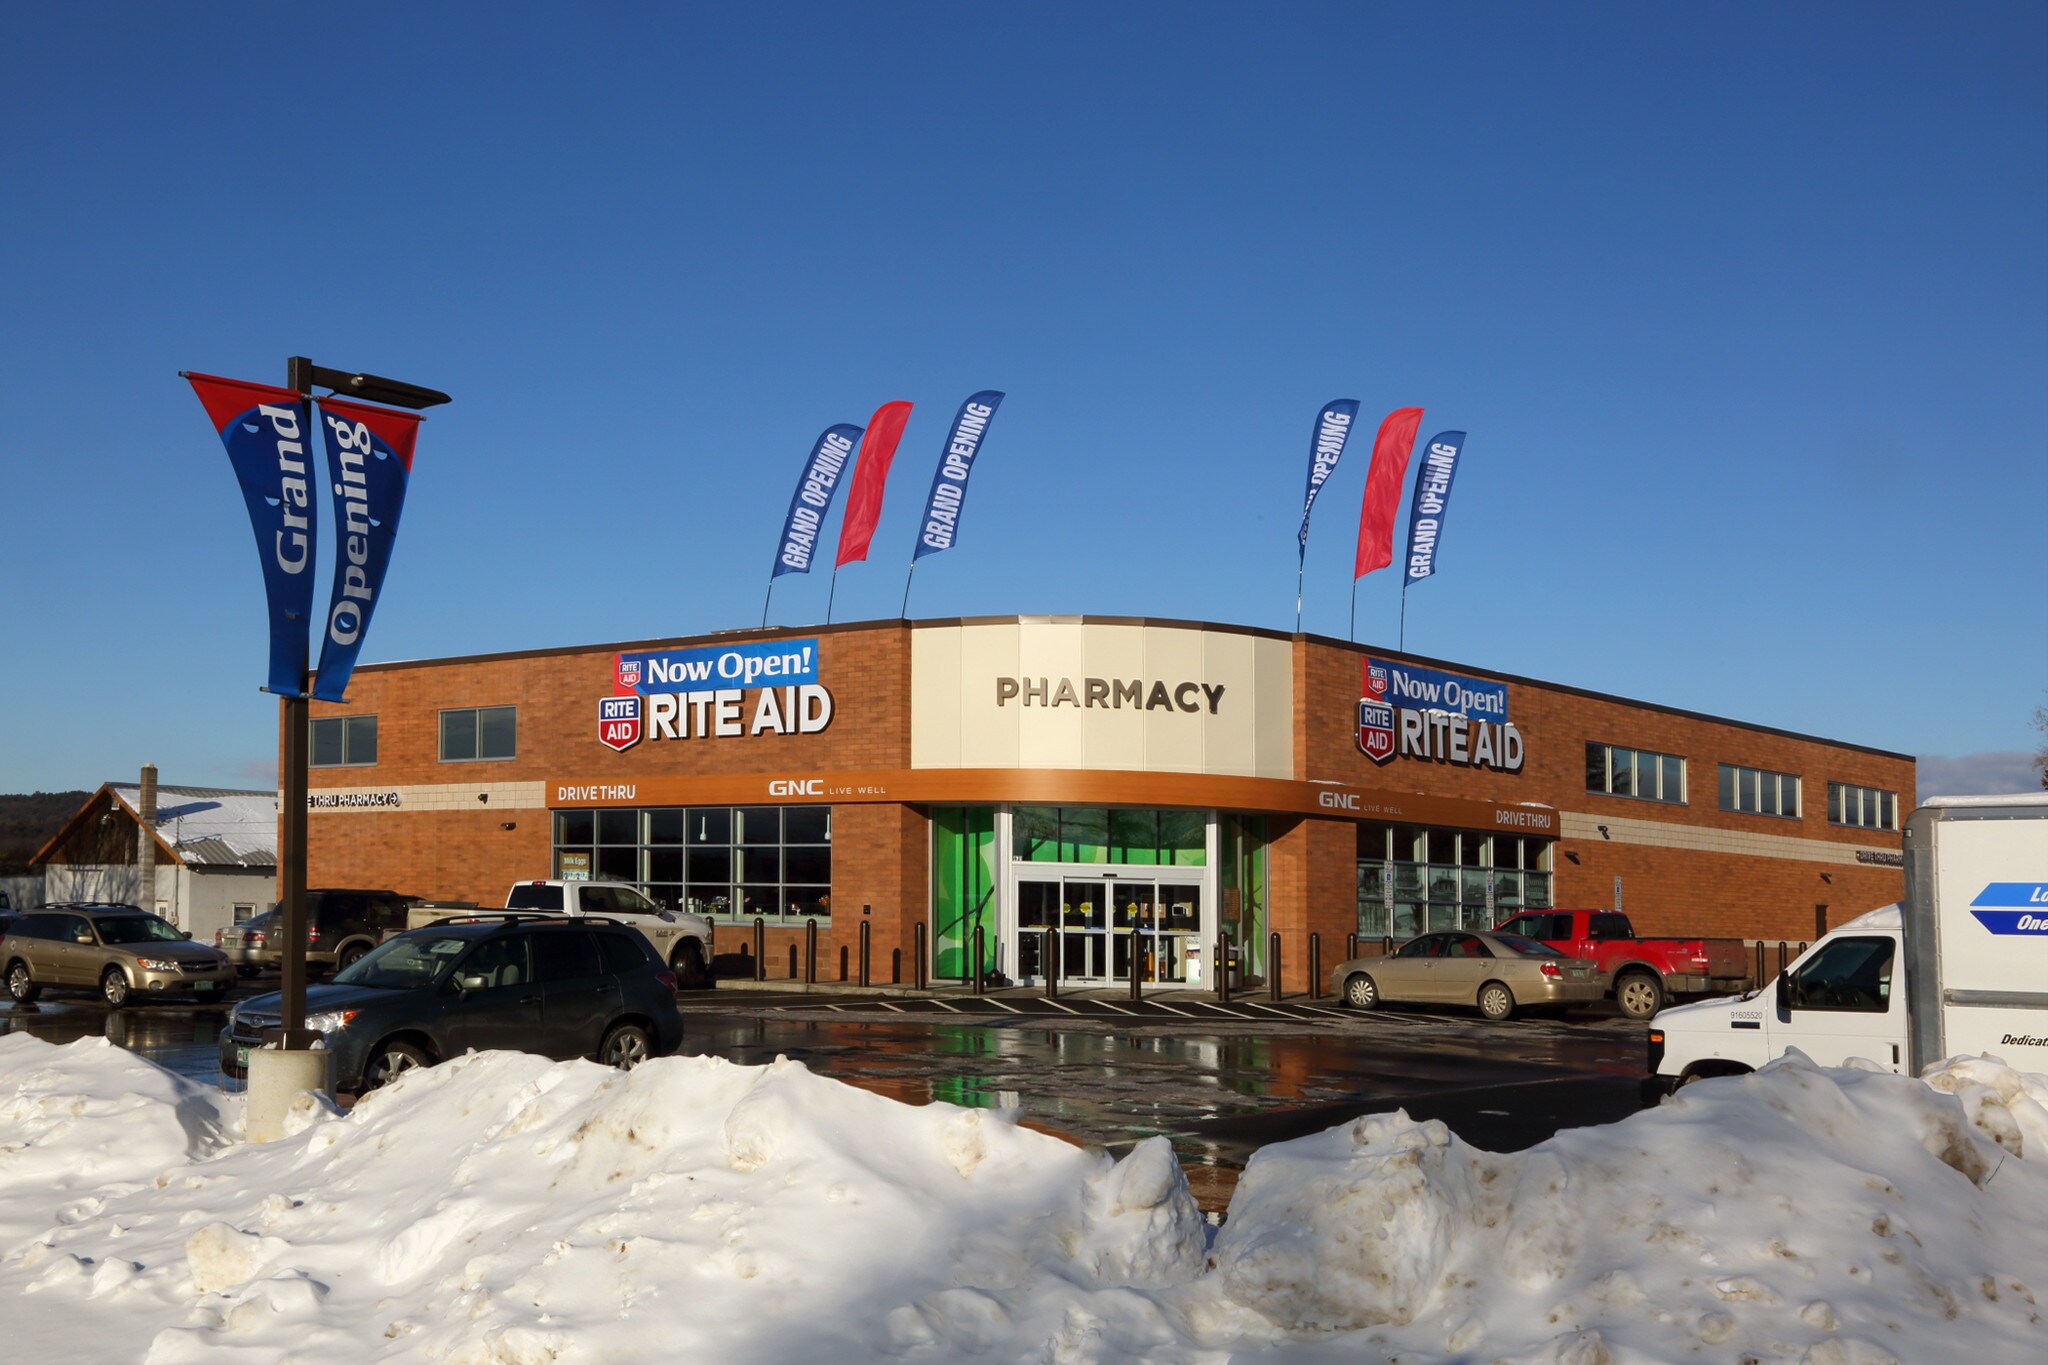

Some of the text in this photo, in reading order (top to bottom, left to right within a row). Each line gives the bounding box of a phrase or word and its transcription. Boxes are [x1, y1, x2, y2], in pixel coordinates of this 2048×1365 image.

[923, 402, 992, 549] GRAND OPENING
[258, 404, 308, 575] Grand
[782, 432, 853, 569] GRAND OPENING
[1409, 443, 1457, 578] GRAND OPENING
[329, 415, 373, 646] Opening
[620, 664, 640, 672] RITE
[648, 647, 811, 685] Now Open!
[1370, 668, 1385, 679] RITE
[622, 674, 638, 683] AID
[1372, 680, 1384, 689] AID
[996, 677, 1226, 715] PHARMACY
[1392, 670, 1504, 715] Now Open!
[605, 702, 635, 718] RITE
[649, 684, 832, 739] RITE AID
[1364, 710, 1390, 727] RITE
[606, 722, 632, 740] AID
[1404, 709, 1524, 769] RITE AID
[1367, 732, 1389, 750] AID
[558, 784, 636, 801] DRIVE THRU
[768, 780, 887, 796] GNC LIVE WELL
[313, 795, 337, 806] THRU
[339, 794, 388, 806] PHARMACY
[1318, 791, 1402, 815] GNC LIVE WELL
[1496, 810, 1551, 829] DRIVE THRU
[575, 857, 587, 866] Eggs
[1730, 1011, 1763, 1020] 91605520
[2001, 1034, 2048, 1047] Dedicat
